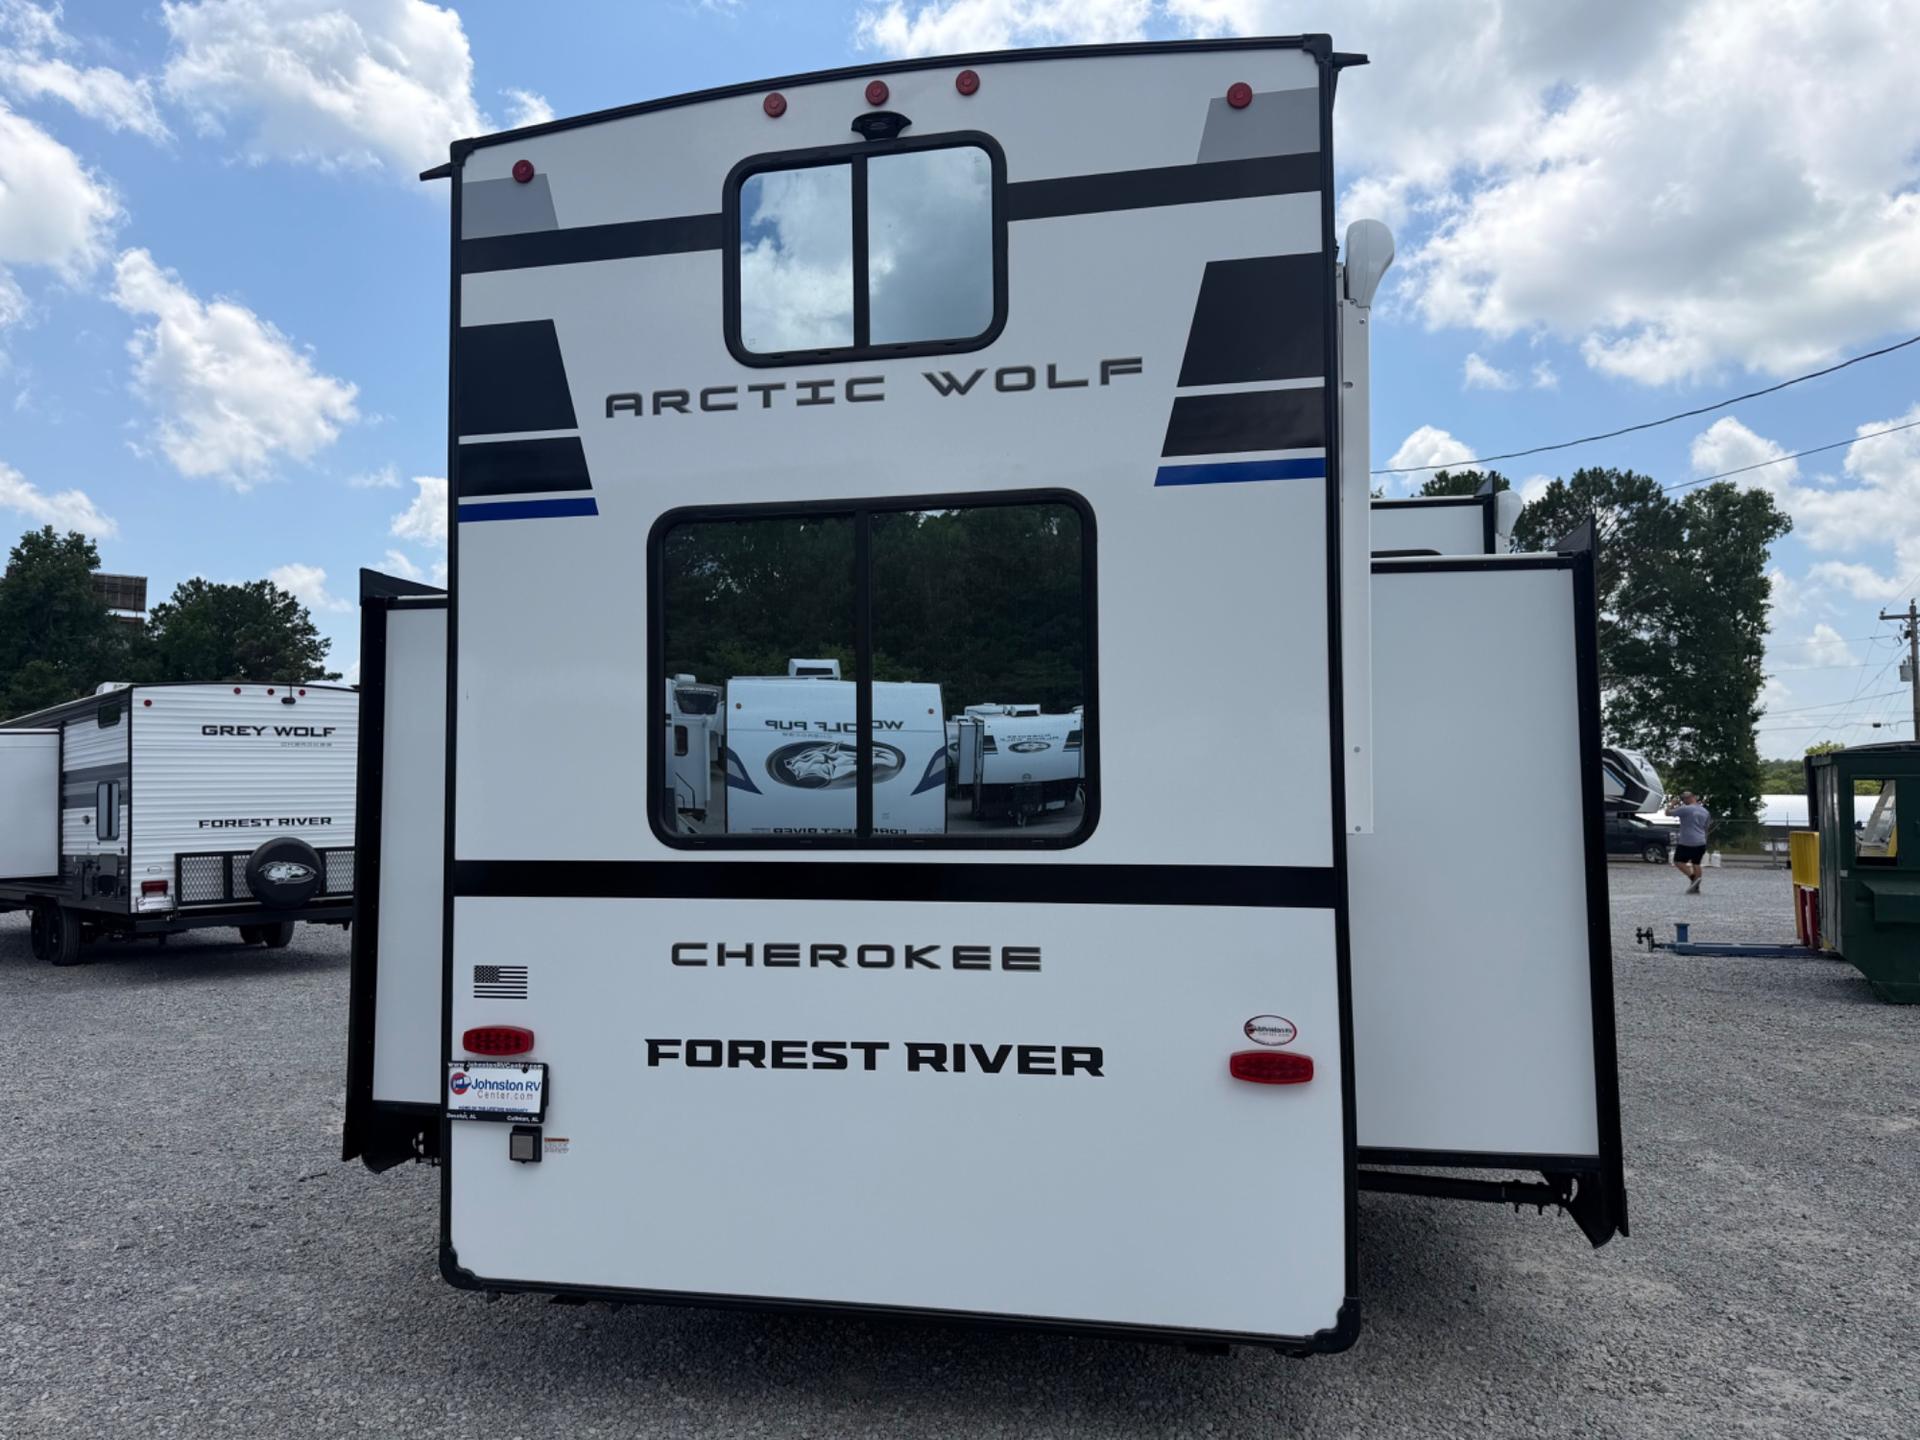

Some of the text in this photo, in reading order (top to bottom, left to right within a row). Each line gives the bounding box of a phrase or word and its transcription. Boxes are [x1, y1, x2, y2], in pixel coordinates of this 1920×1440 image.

[605, 356, 1143, 418] ARCTIC WOLF
[201, 725, 336, 737] GREY WOLF
[199, 817, 332, 828] FOREST RIVER
[670, 942, 1042, 972] CHEROKEE
[644, 1038, 1105, 1077] FOREST RIVER
[472, 1078, 541, 1092] Johnston RV
[477, 1090, 533, 1100] Center.com
